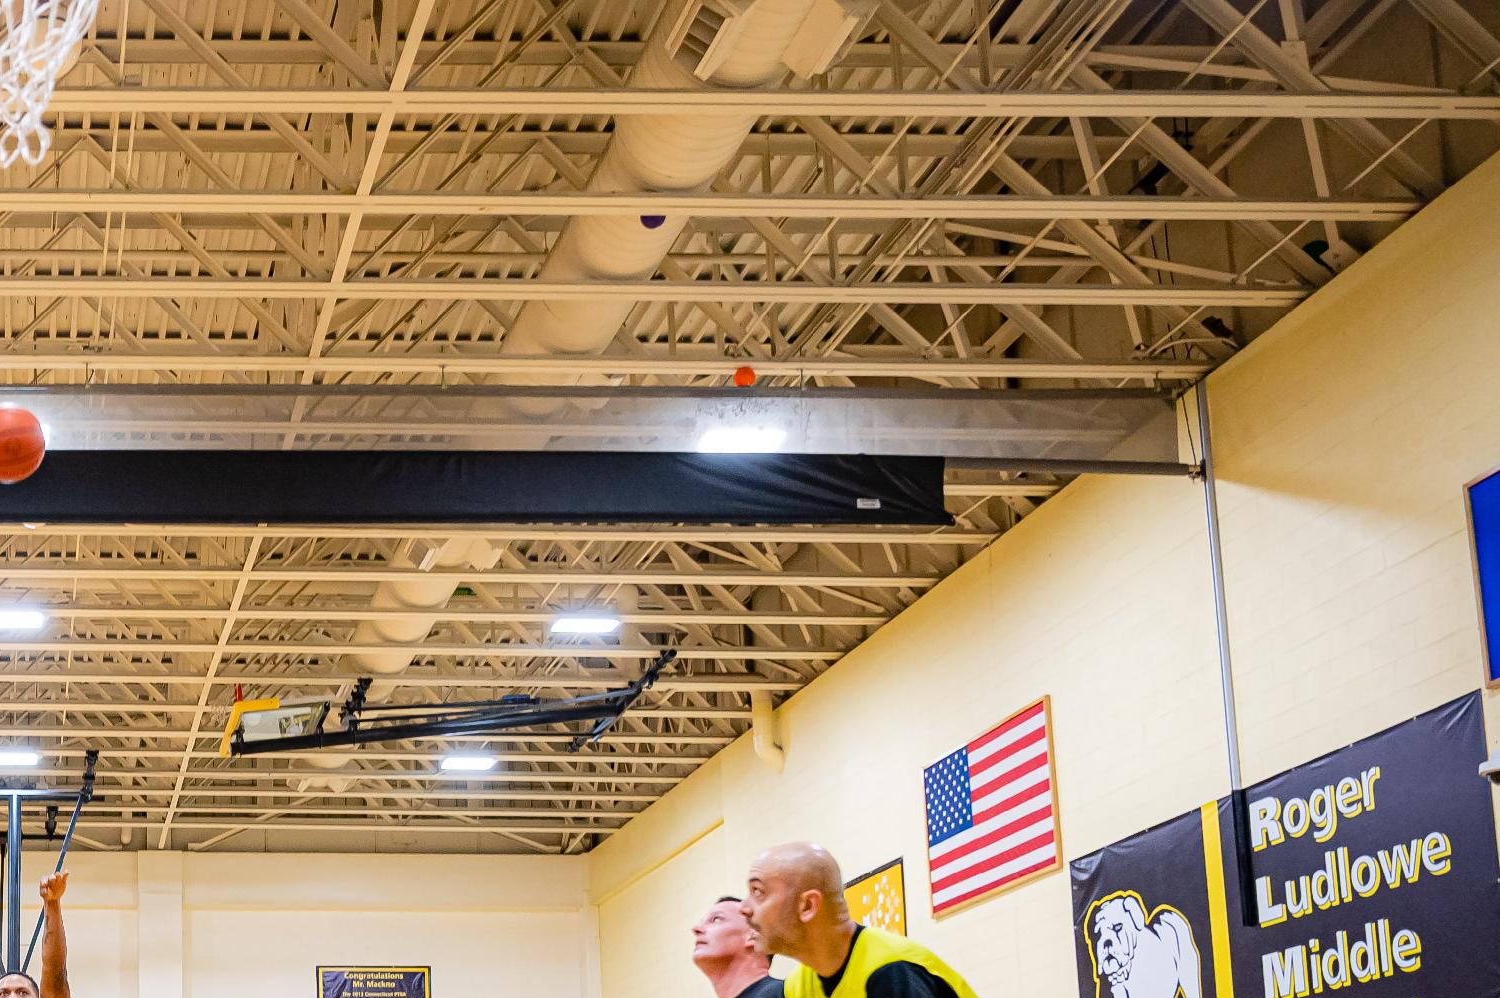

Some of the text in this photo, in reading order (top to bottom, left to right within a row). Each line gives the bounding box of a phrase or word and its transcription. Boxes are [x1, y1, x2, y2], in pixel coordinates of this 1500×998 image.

[1249, 766, 1380, 852] Roger
[1255, 832, 1451, 928] Ludlowe
[344, 972, 404, 980] Congratulations
